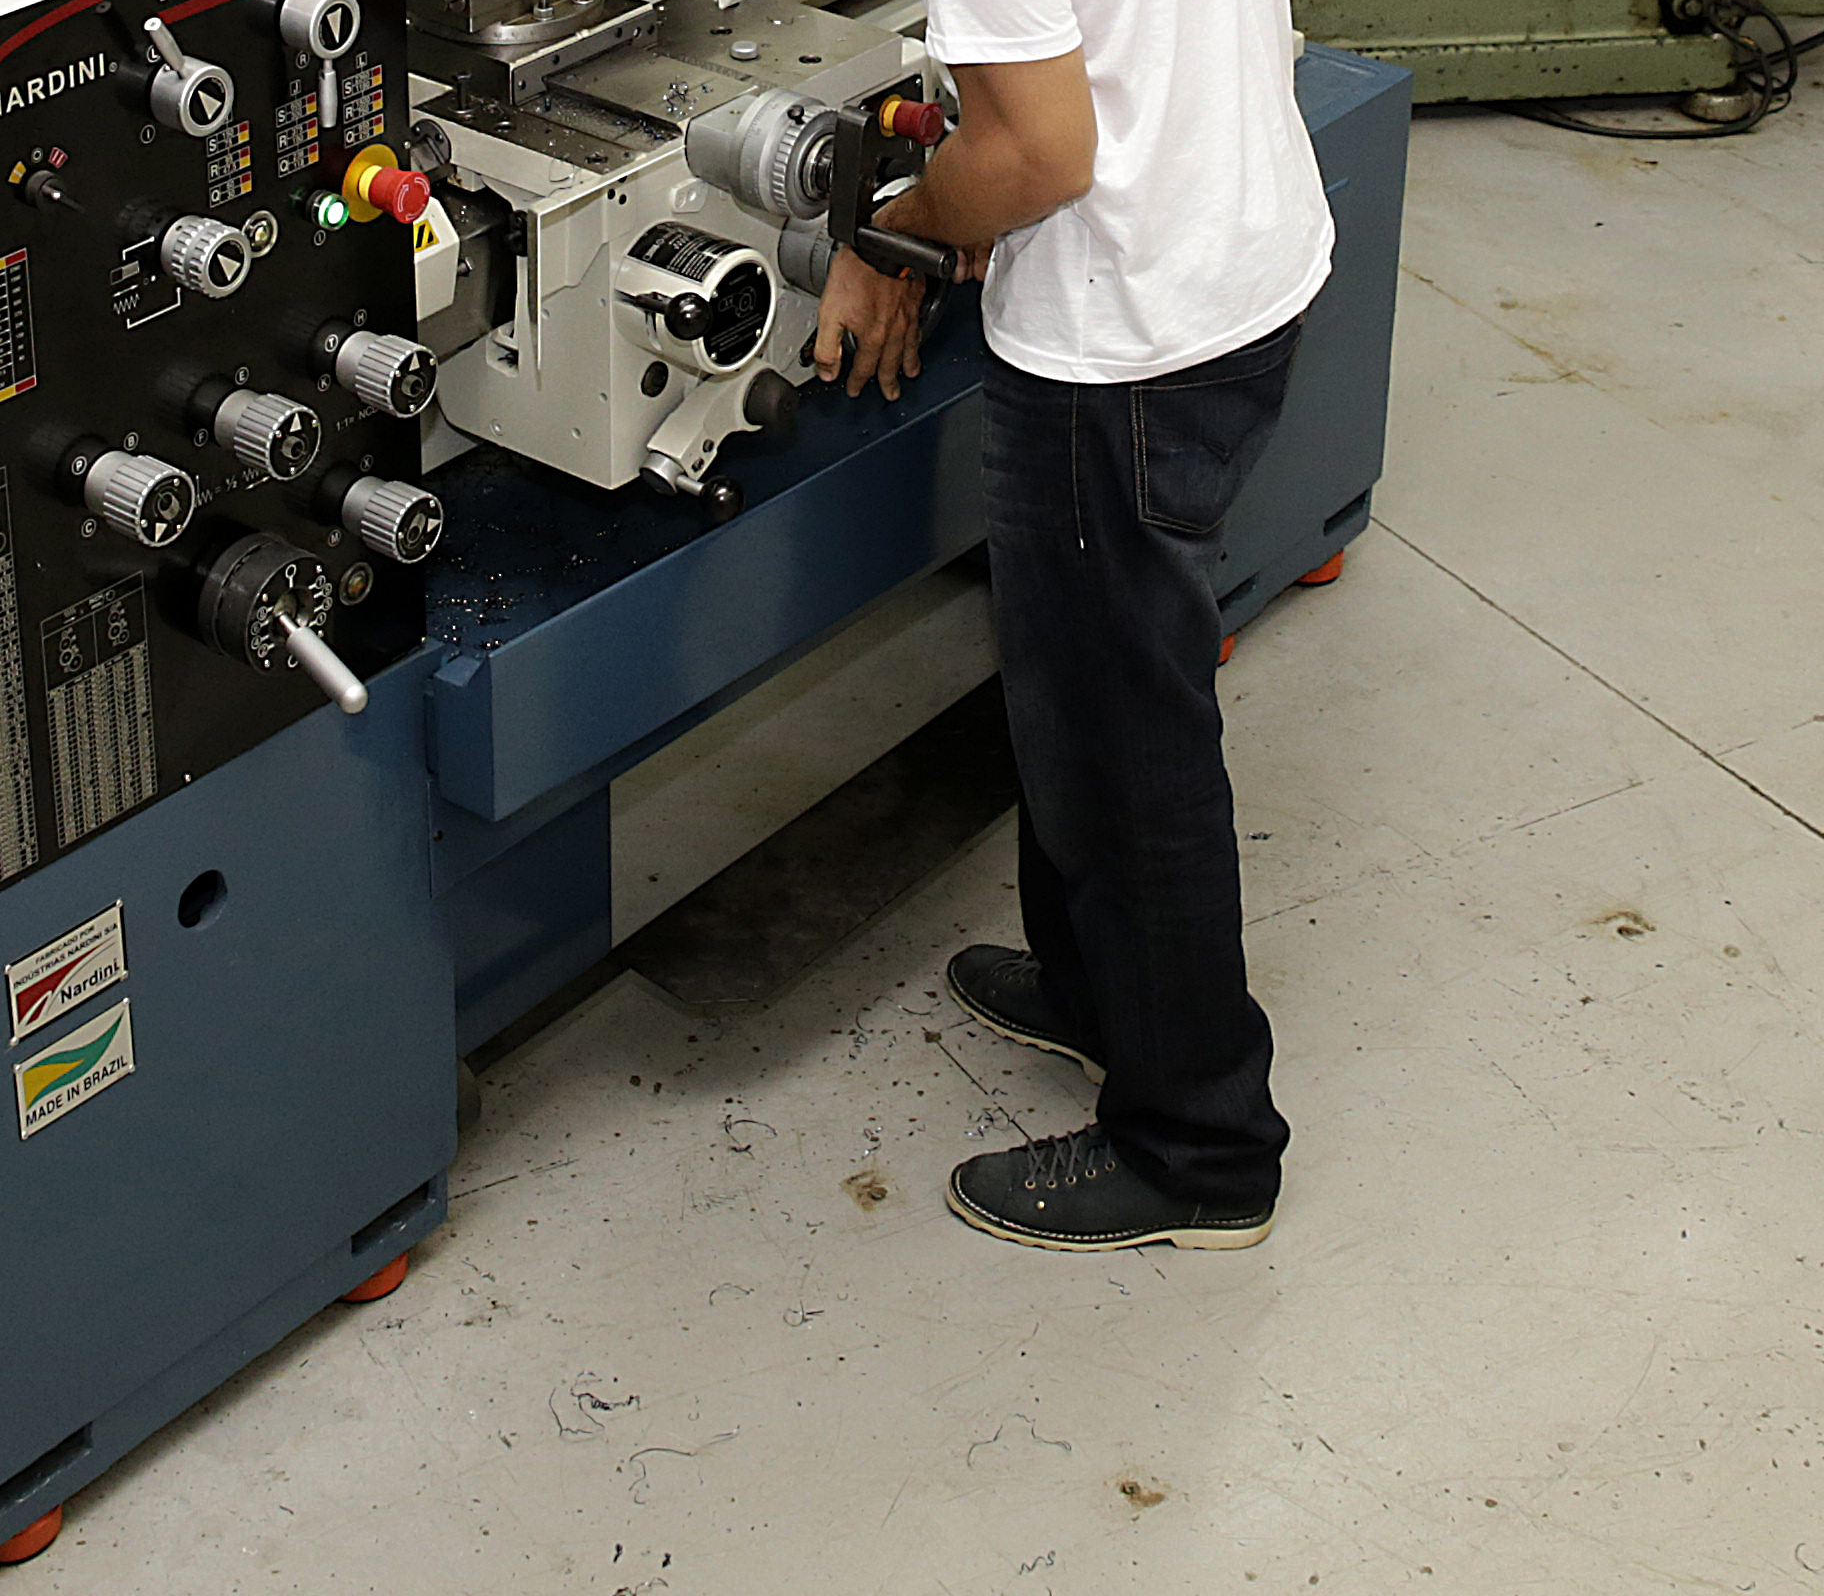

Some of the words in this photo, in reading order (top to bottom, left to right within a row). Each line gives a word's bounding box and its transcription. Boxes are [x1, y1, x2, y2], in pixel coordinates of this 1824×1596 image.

[67, 931, 102, 956] NARDINI
[60, 957, 120, 1004] Nardini
[26, 1093, 63, 1127] MADE
[66, 1084, 80, 1102] IN
[83, 1055, 129, 1091] BRAZIL
